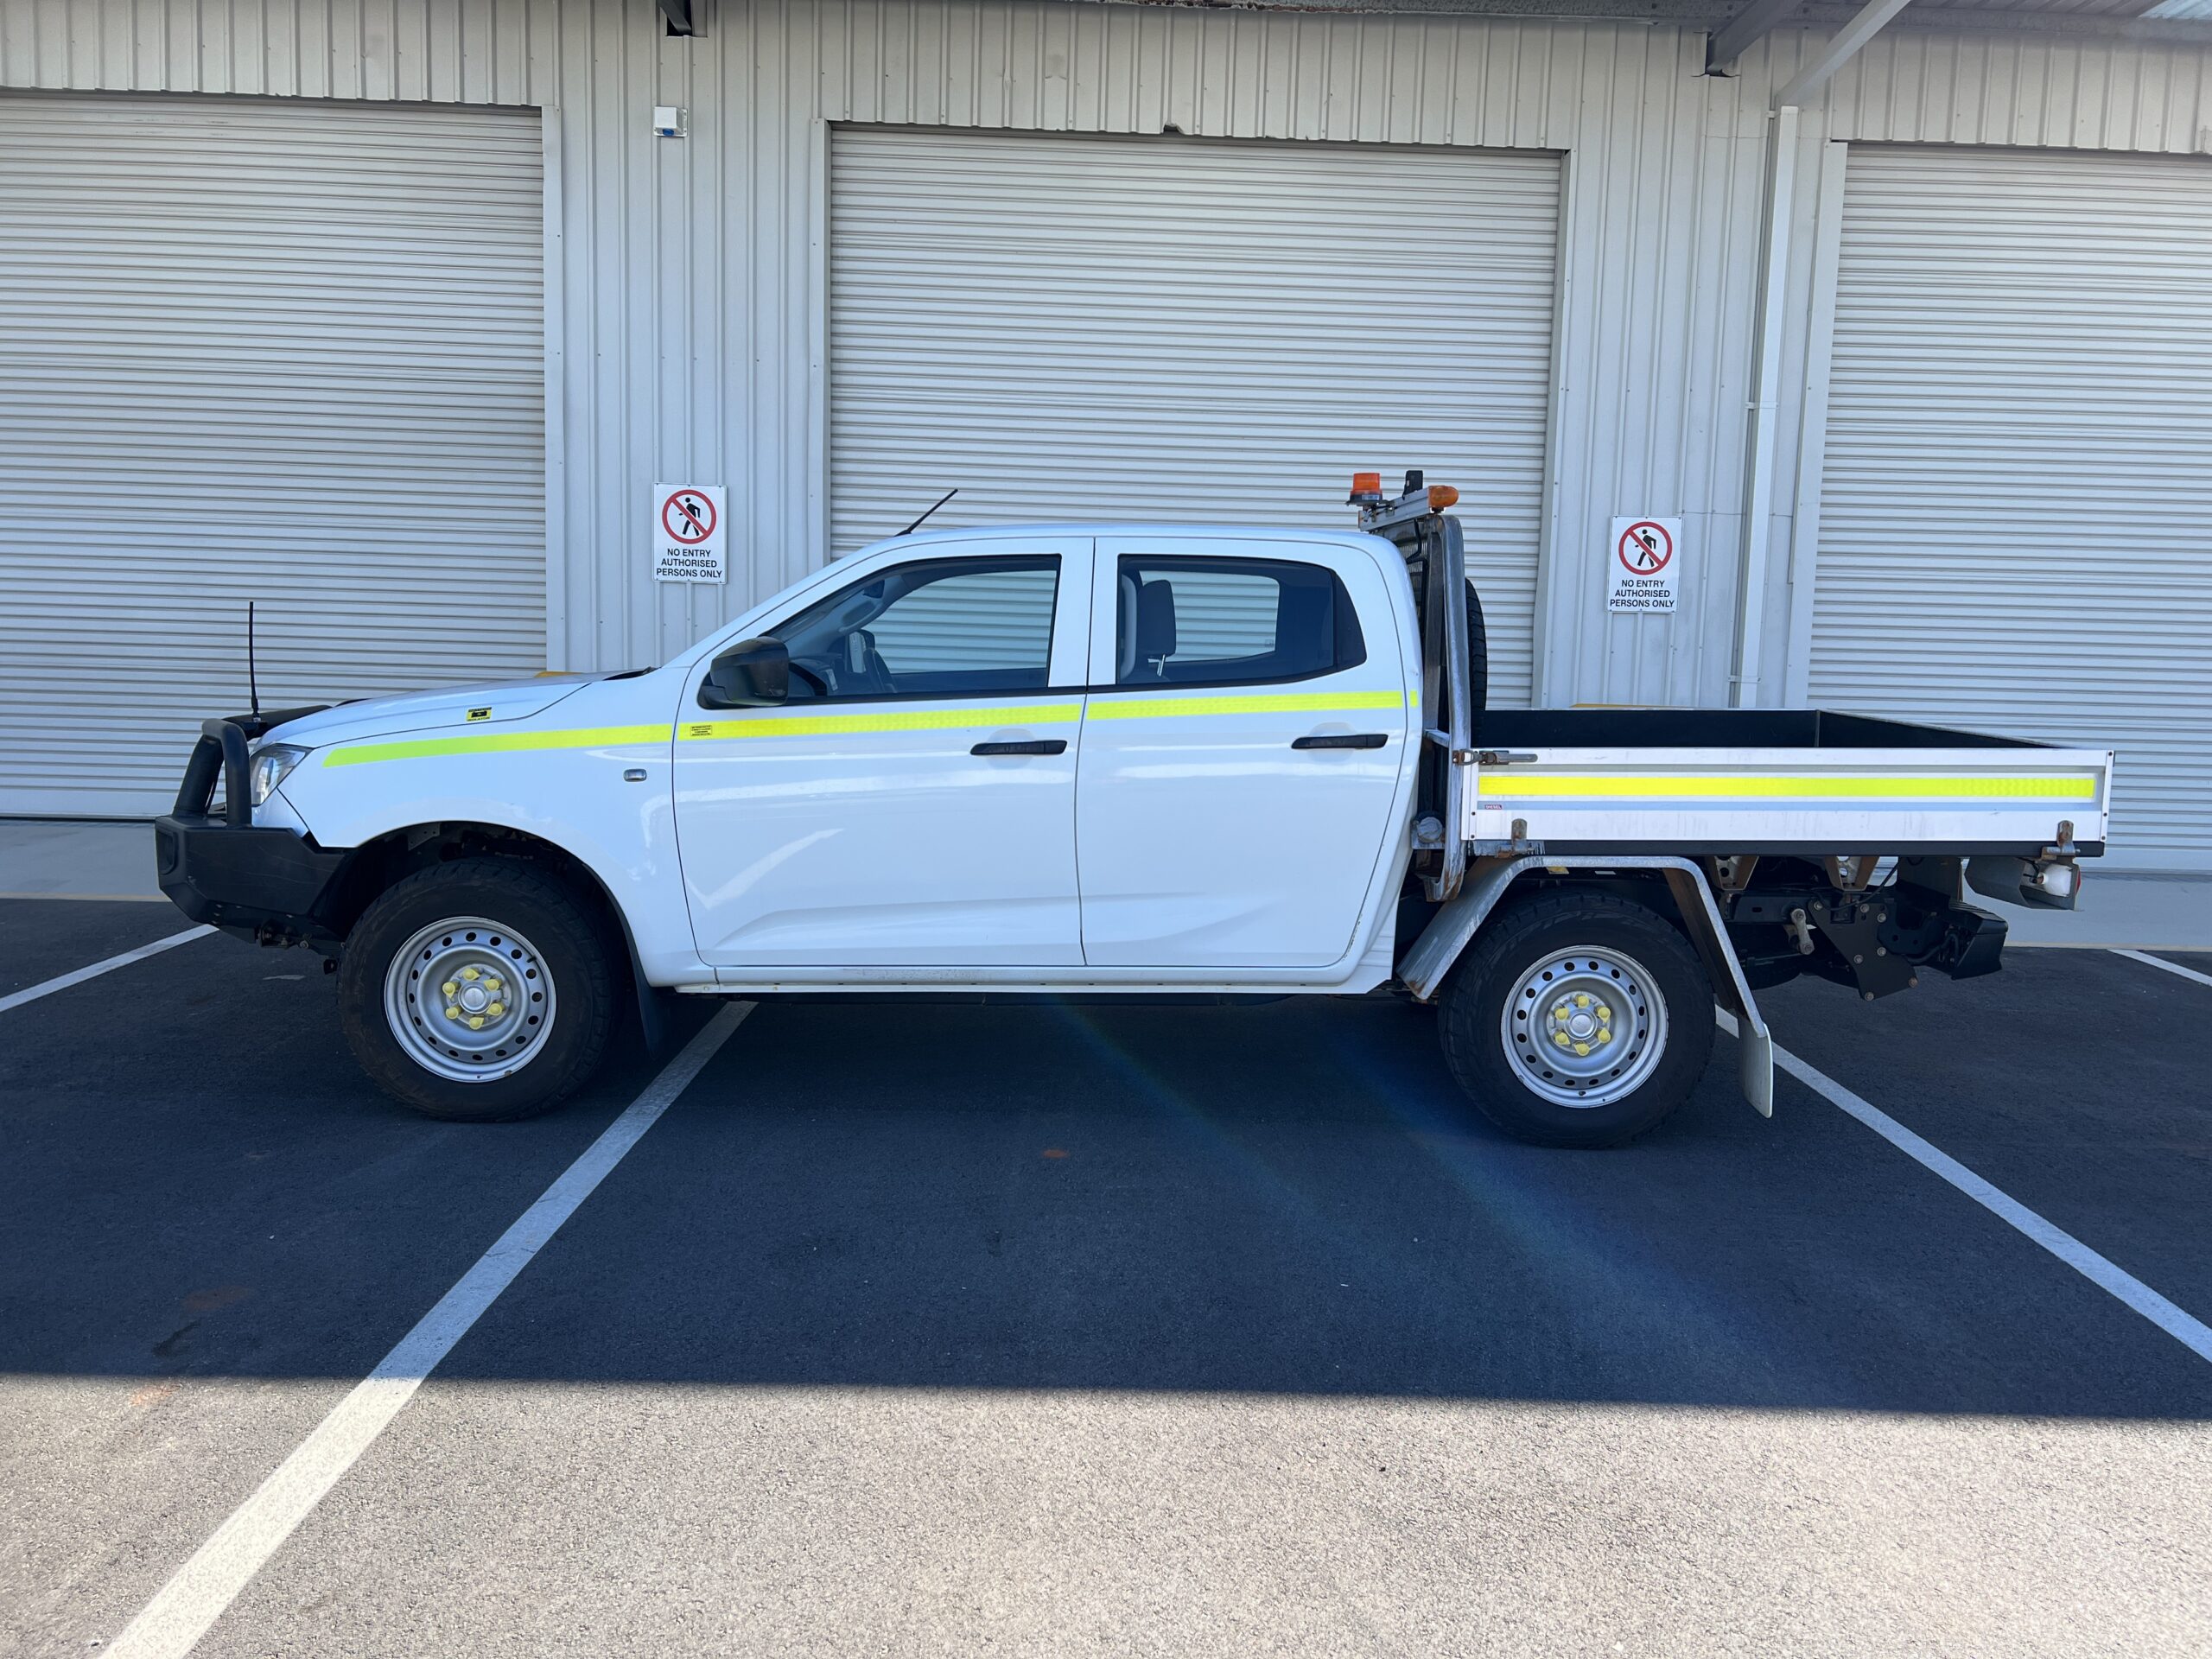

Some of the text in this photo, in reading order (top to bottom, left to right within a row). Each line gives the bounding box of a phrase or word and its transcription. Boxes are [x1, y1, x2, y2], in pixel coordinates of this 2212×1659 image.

[667, 548, 711, 557] NO ENTRY
[661, 558, 717, 568] AUTHORISED
[657, 569, 722, 578] PERSONS ONLY
[1621, 579, 1634, 588] NO
[1615, 589, 1670, 598] AUTHORISED
[1610, 599, 1649, 607] PERSONS
